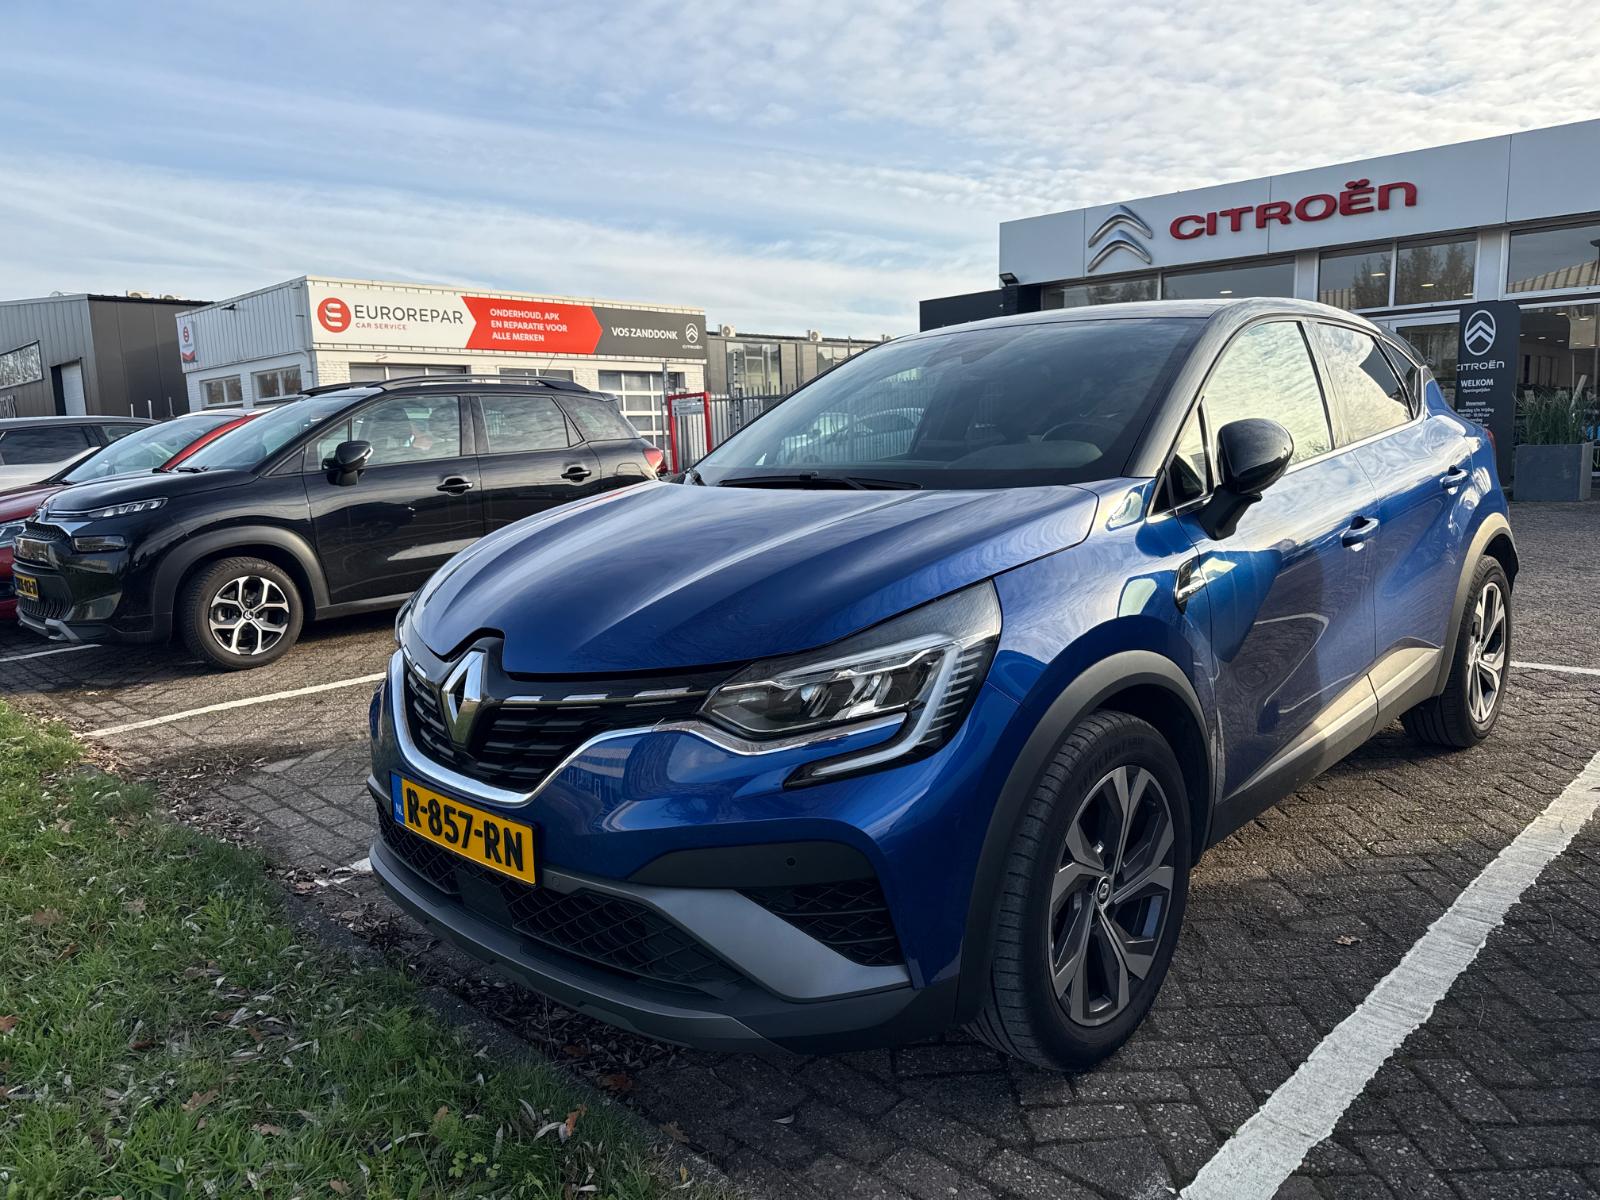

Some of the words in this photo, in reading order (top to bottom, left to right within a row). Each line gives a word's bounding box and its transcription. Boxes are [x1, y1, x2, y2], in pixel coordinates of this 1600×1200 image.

[1169, 178, 1418, 240] CITROËN
[354, 304, 464, 325] EUROREPAR
[489, 308, 543, 320] ONDERHOUD,
[544, 312, 560, 321] APK
[374, 322, 407, 331] SERVICE
[491, 320, 502, 328] EN
[503, 320, 544, 331] REPARATIE
[545, 323, 568, 332] VOOR
[492, 331, 511, 340] ALLE
[512, 332, 545, 342] MERKEN
[611, 326, 629, 337] VOS
[630, 328, 678, 340] ZANDDONK
[1461, 379, 1494, 387] WELKOM
[406, 787, 524, 872] R-857-RN
